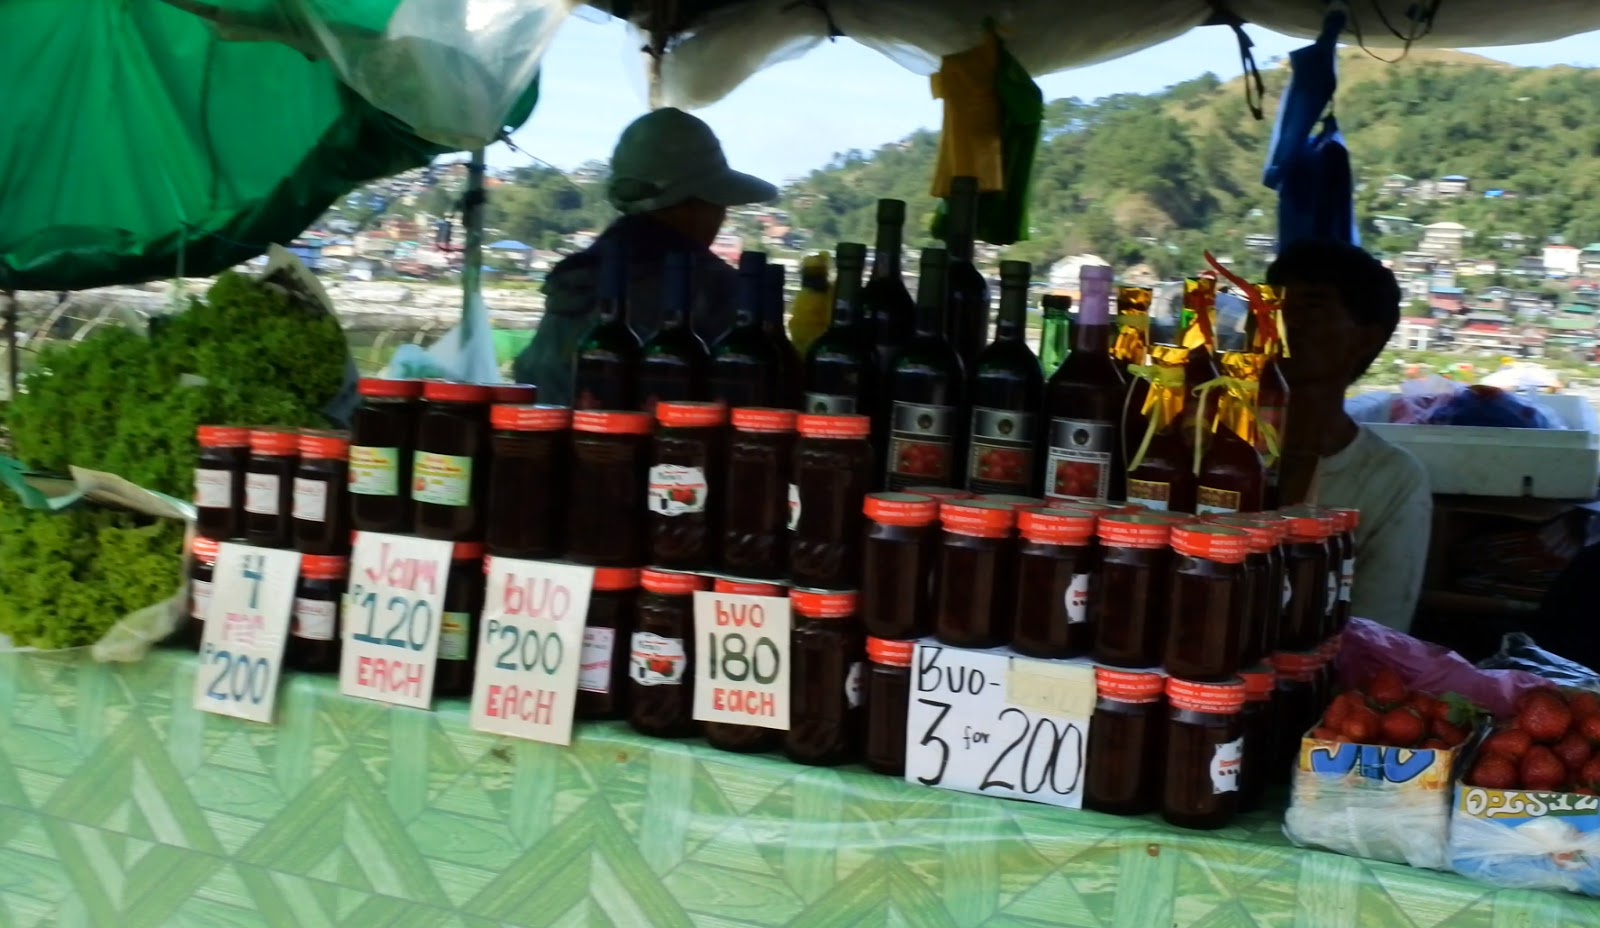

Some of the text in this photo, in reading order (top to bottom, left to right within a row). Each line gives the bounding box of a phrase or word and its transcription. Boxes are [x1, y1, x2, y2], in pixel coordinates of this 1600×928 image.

[242, 554, 265, 609] 4
[357, 655, 426, 698] EACH
[709, 632, 781, 685] 180
[917, 698, 1083, 795] 3 for 200
